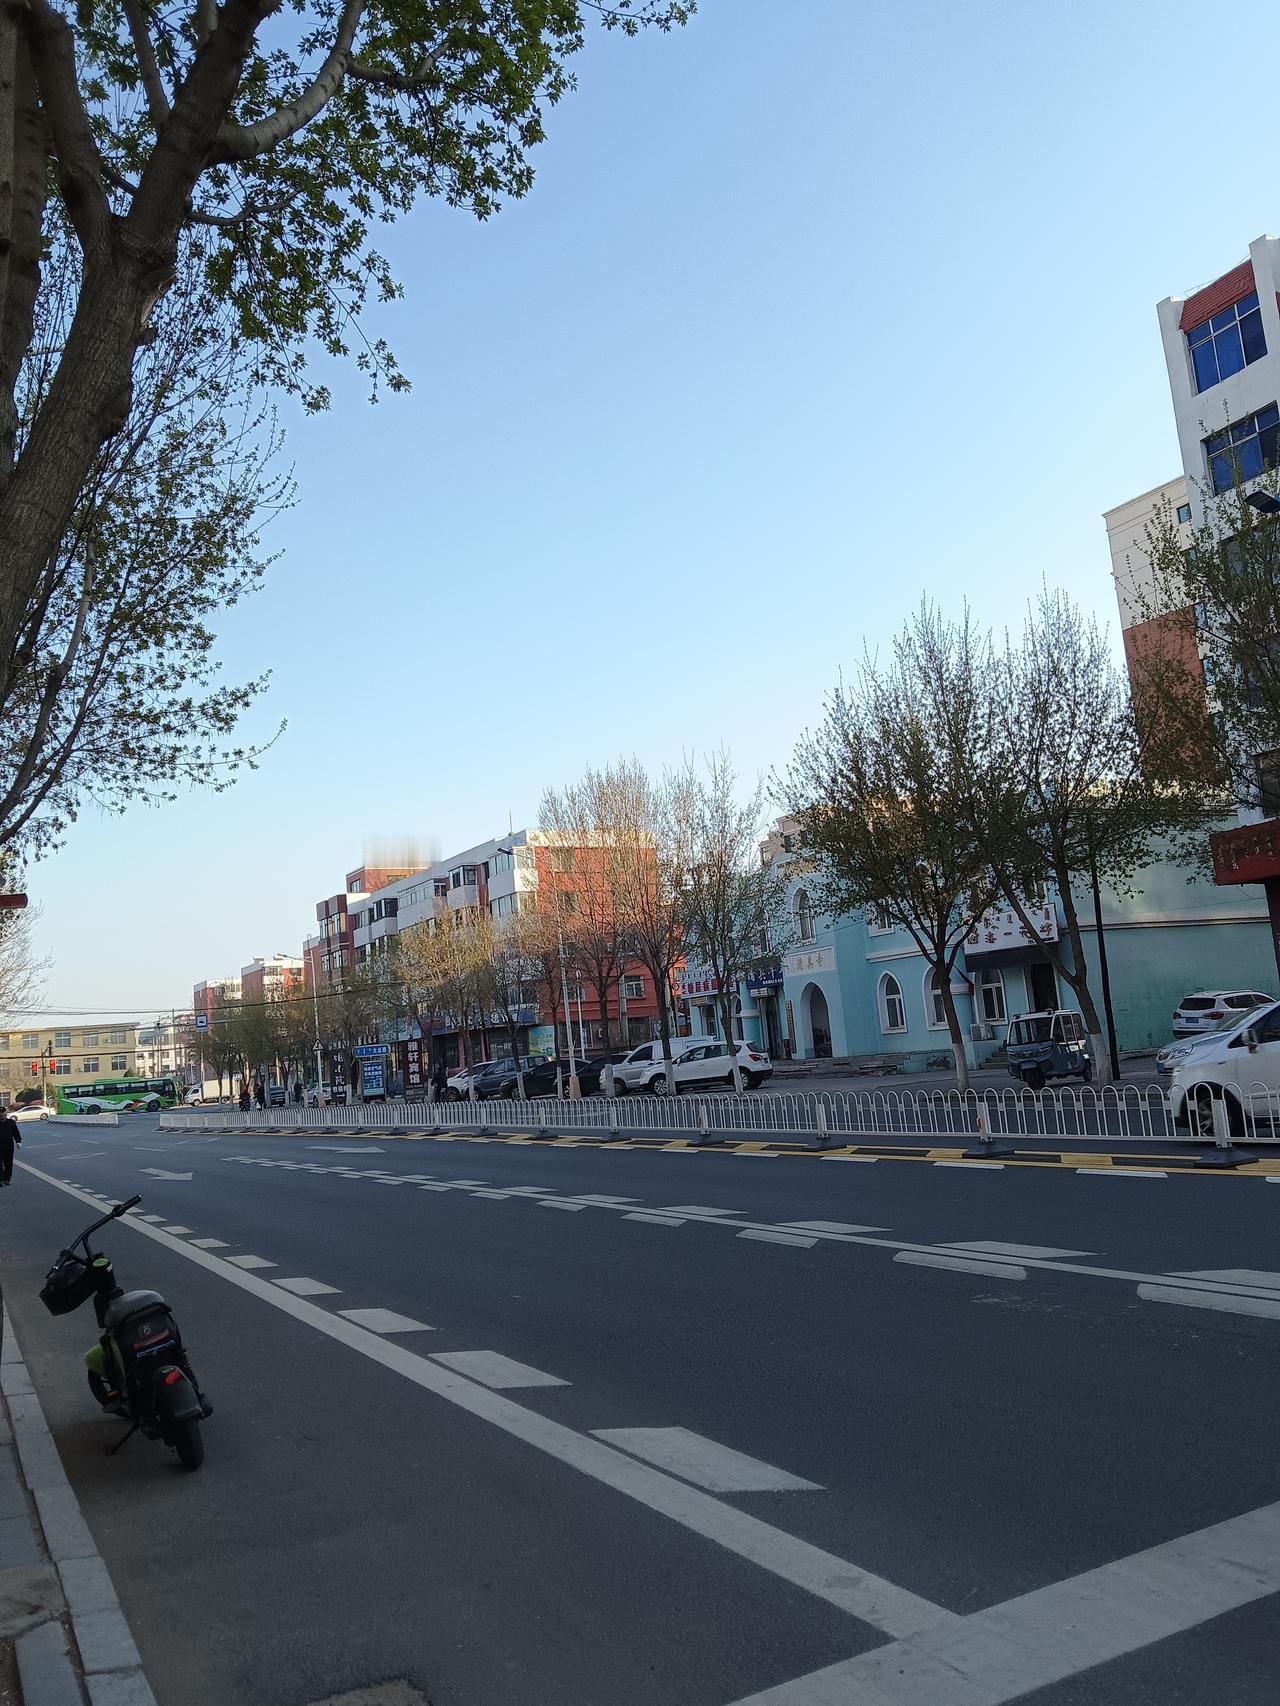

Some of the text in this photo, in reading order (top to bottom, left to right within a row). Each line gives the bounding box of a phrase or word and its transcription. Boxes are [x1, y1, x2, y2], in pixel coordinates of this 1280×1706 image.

[796, 952, 823, 970] 清真寺
[408, 1042, 420, 1083] 雅轩宾馆
